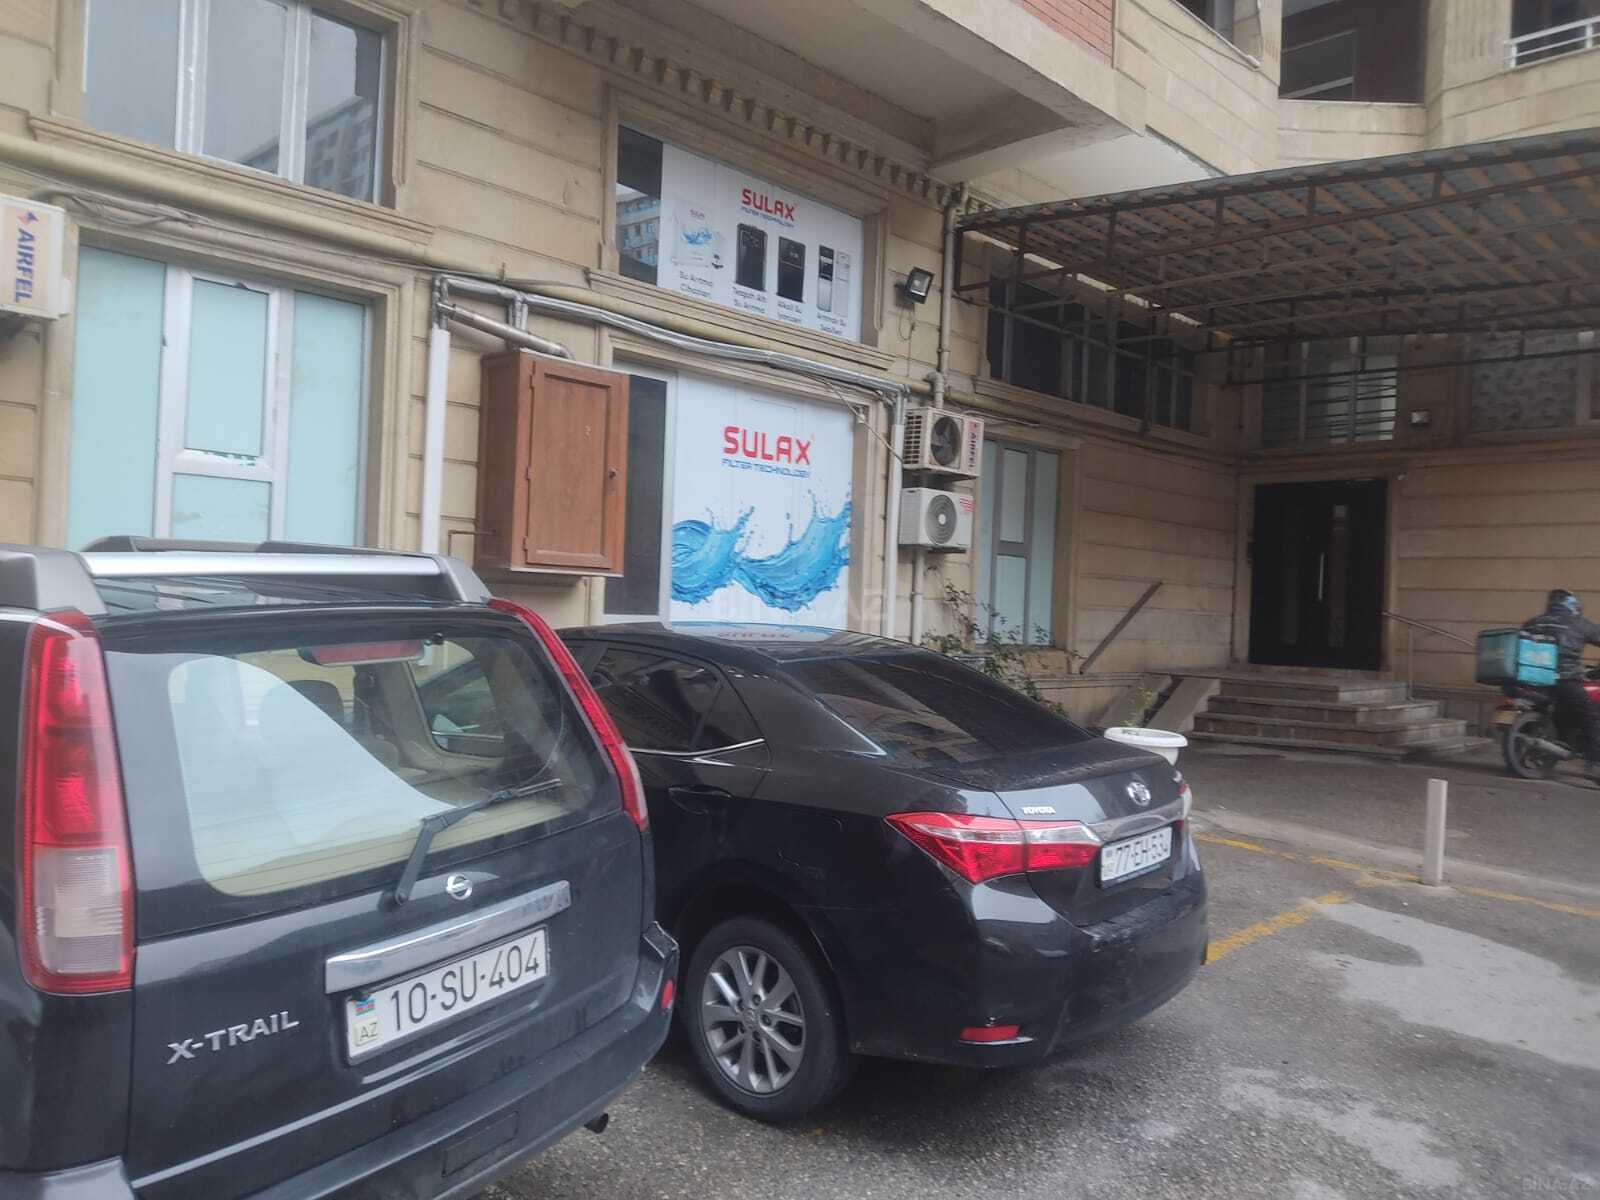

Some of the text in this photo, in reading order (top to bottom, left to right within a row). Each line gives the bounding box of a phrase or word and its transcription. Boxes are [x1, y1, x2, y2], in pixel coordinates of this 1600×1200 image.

[742, 187, 796, 221] SULAX
[723, 426, 811, 465] SULAX
[1022, 806, 1056, 815] TOYOTA
[359, 937, 540, 1042] AZ 10-SU-404
[166, 1011, 299, 1065] X-TRAIL
